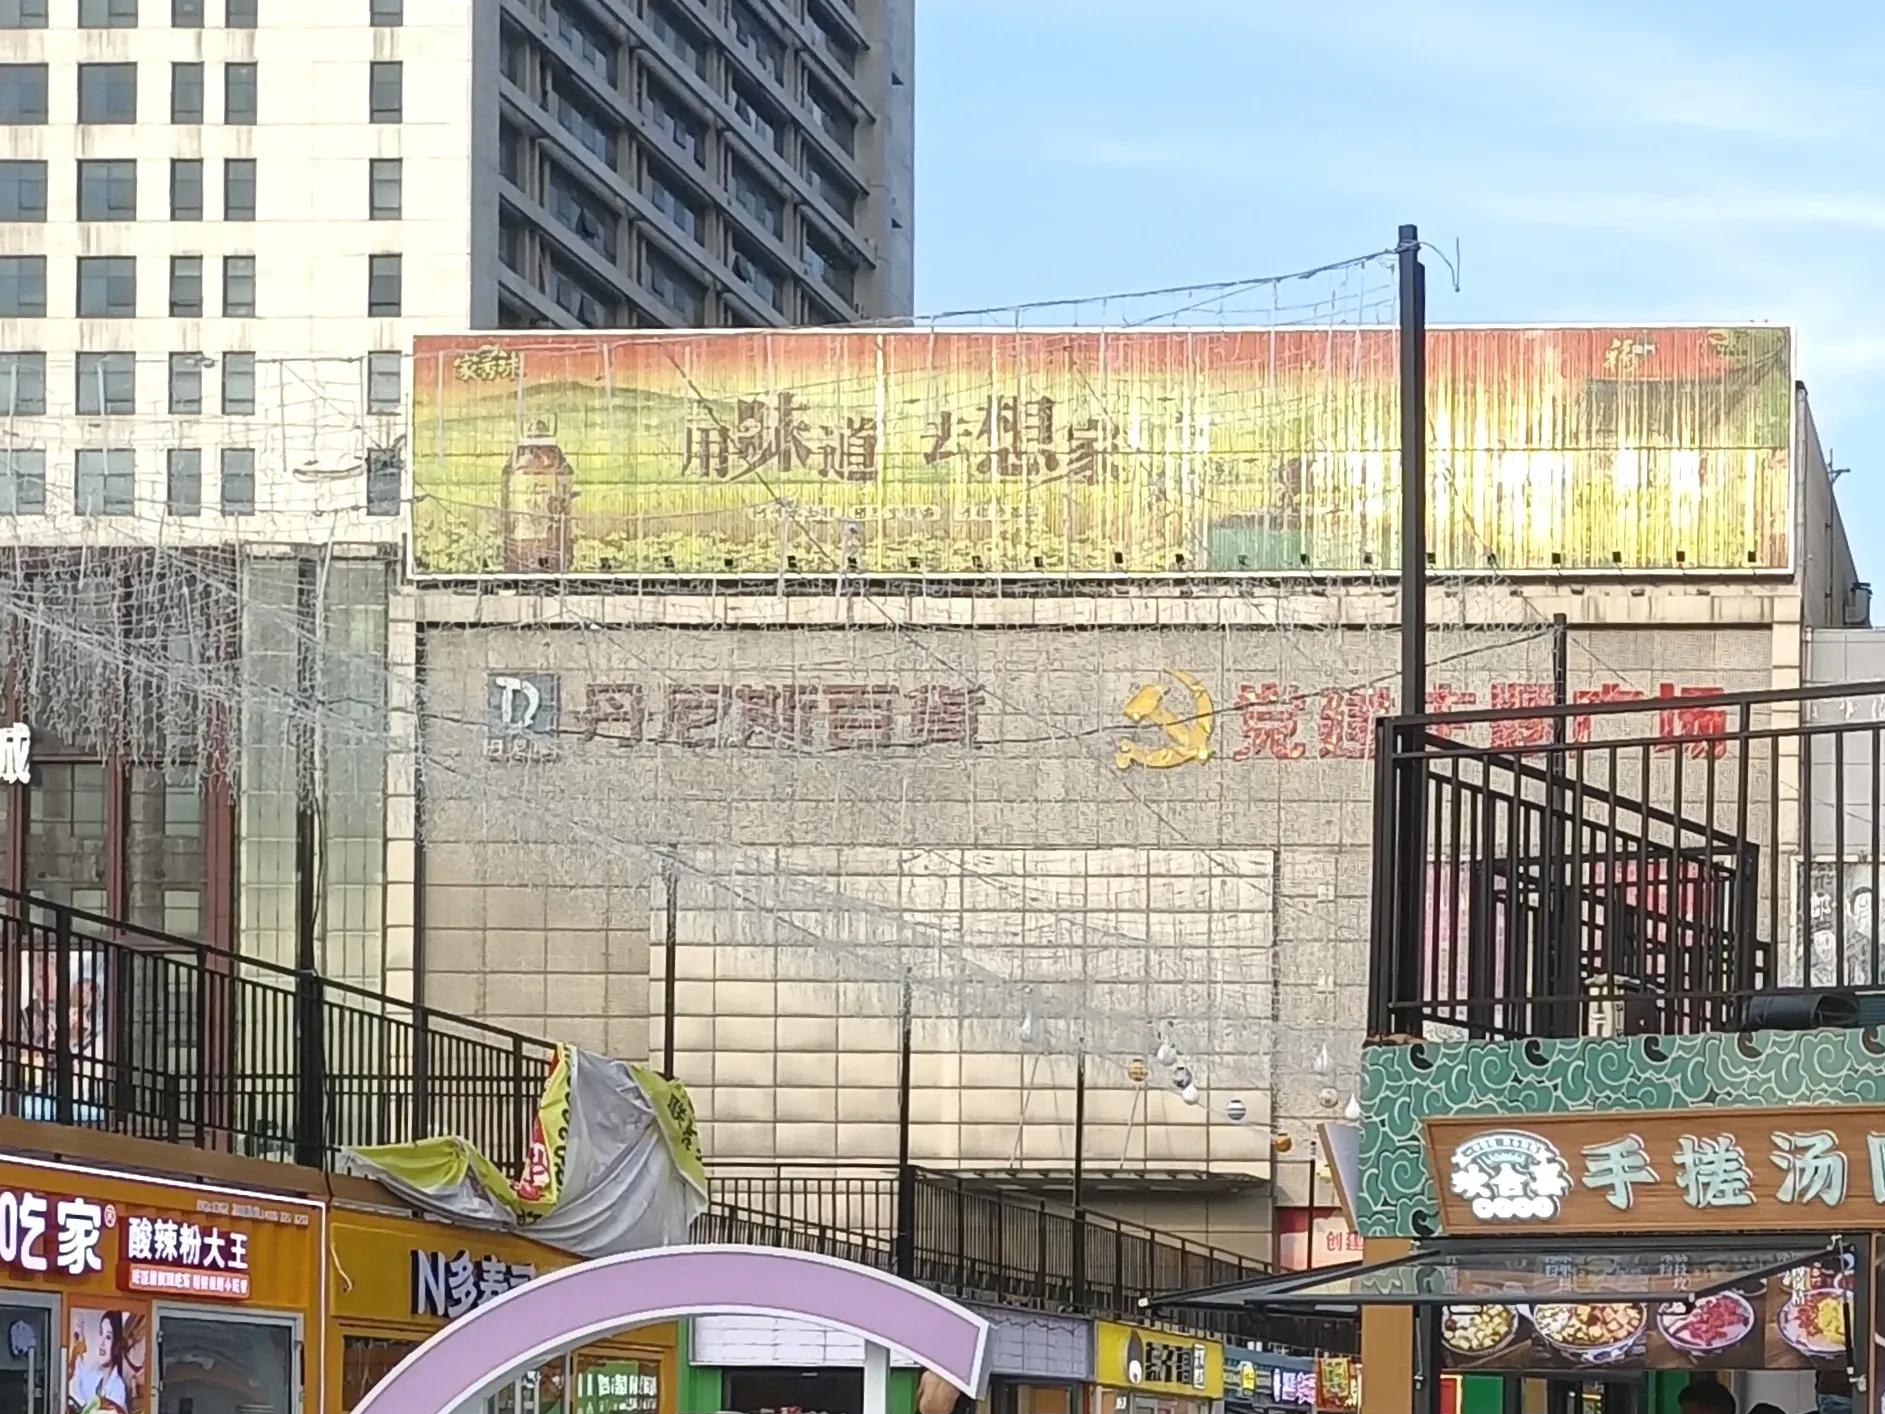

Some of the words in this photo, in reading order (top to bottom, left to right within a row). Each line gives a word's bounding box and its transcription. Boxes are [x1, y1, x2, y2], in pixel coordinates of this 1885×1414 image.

[128, 1217, 249, 1269] 酸辣粉大王
